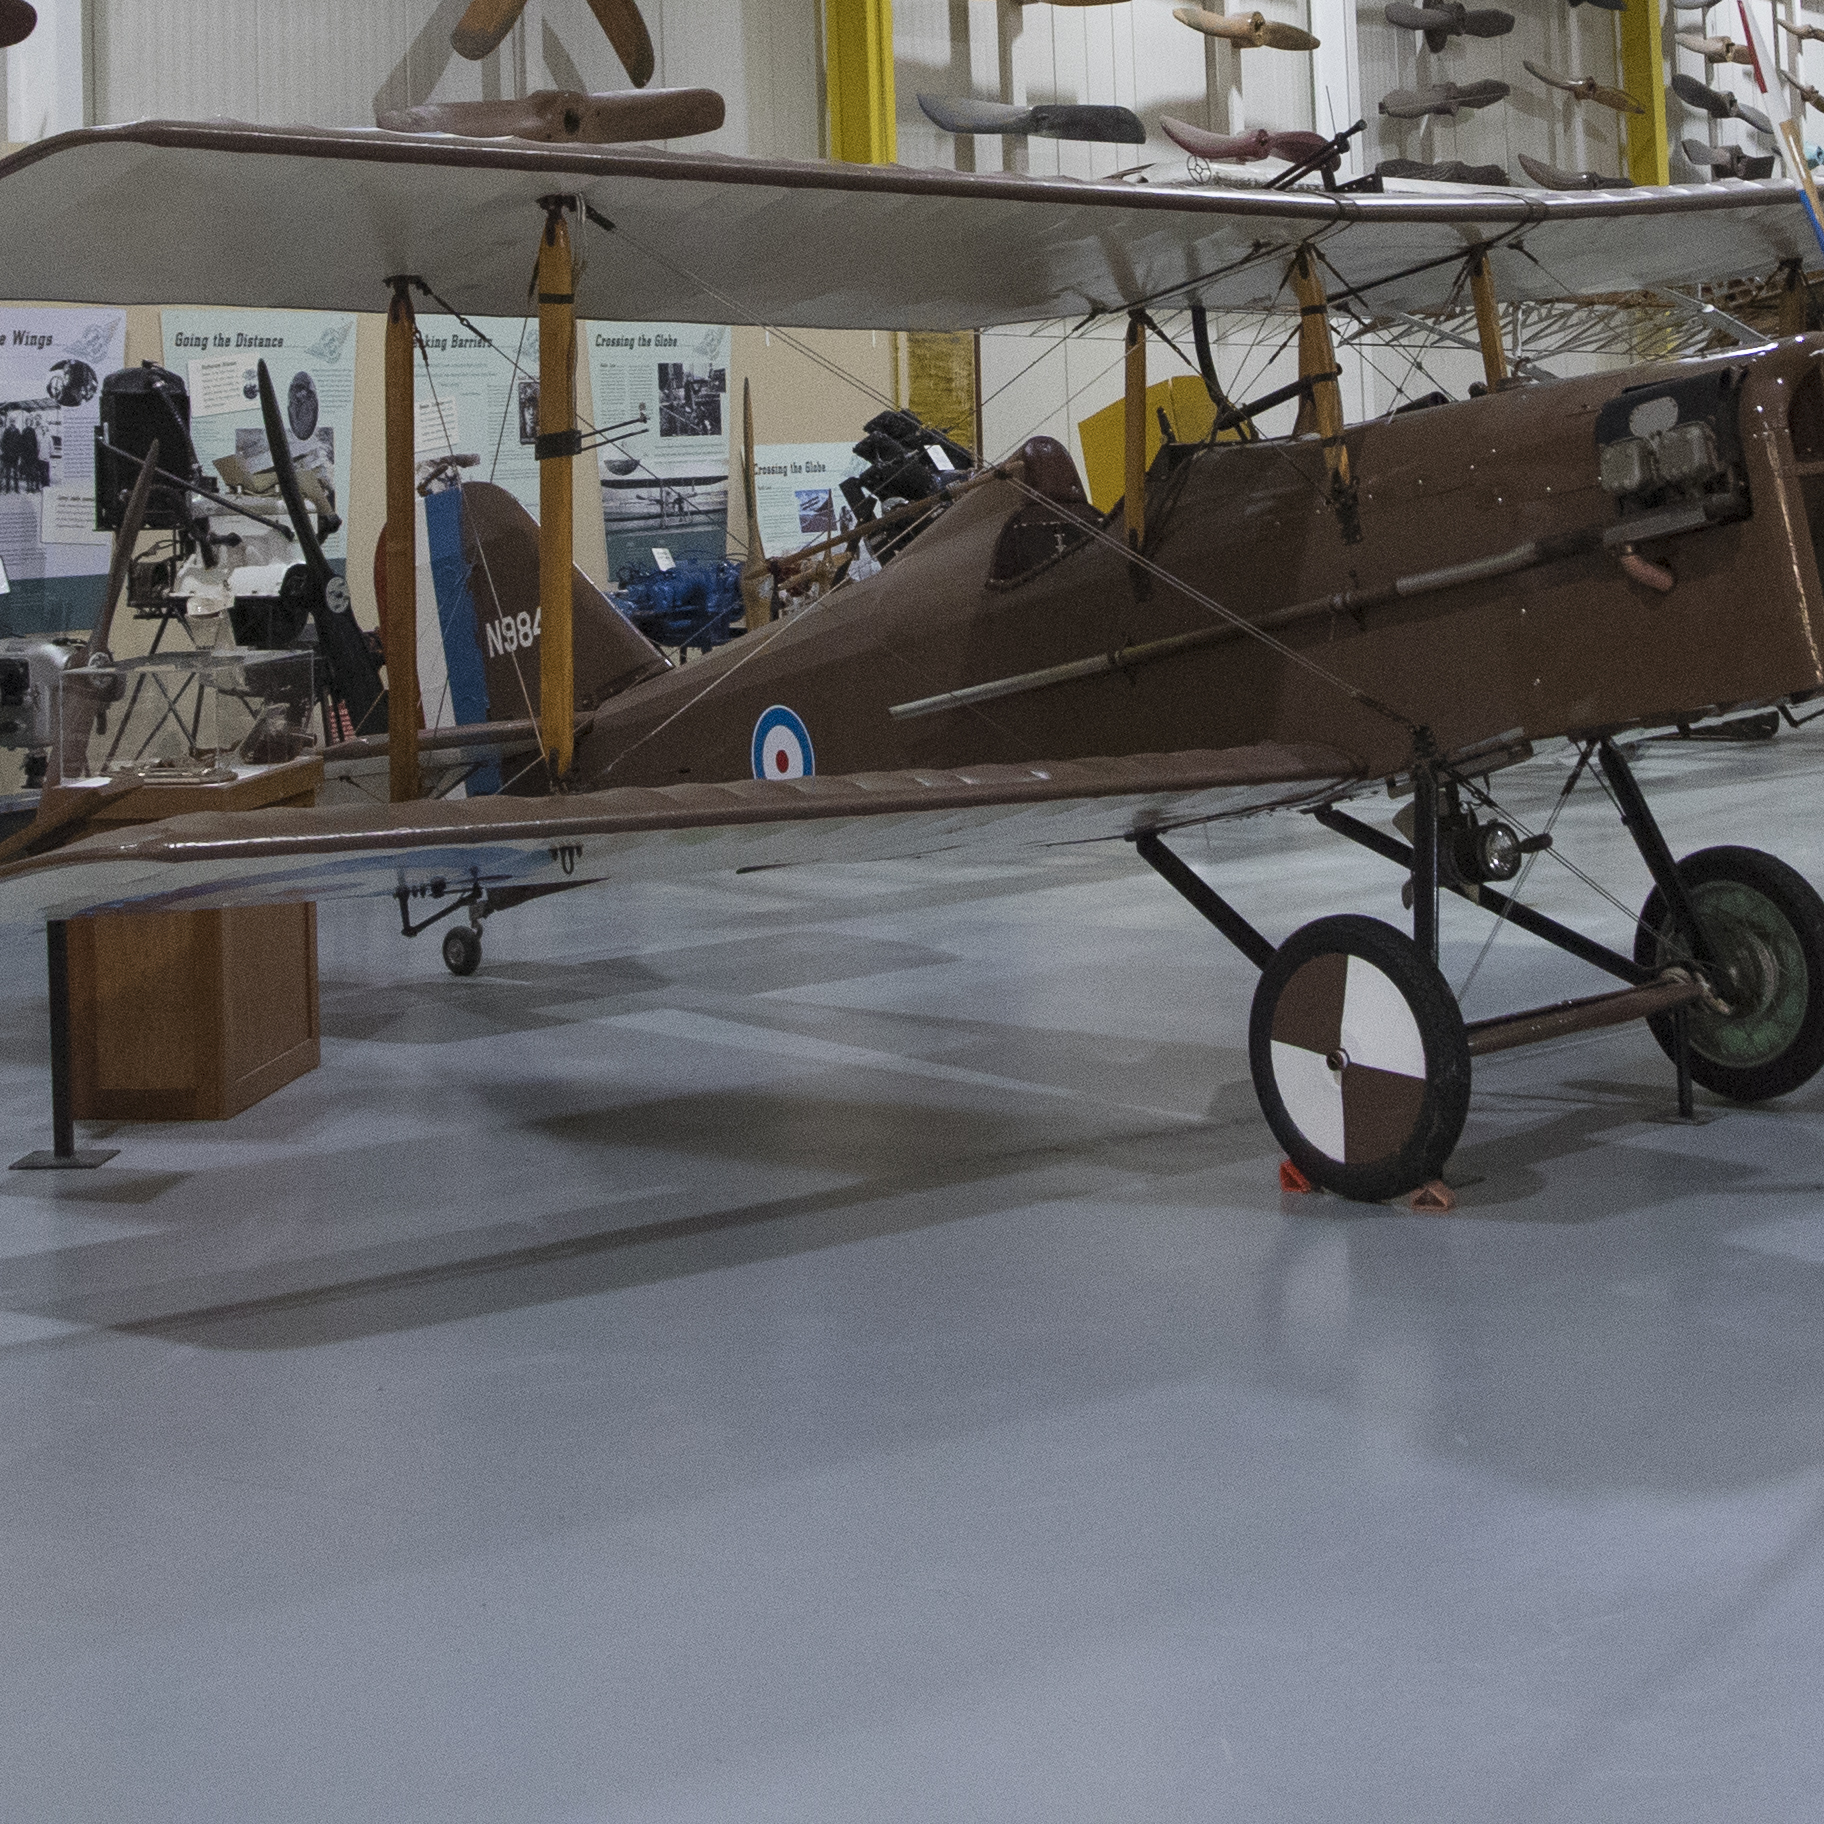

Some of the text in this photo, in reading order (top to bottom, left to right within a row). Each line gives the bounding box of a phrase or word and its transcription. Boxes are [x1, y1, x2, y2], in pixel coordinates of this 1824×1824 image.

[12, 329, 53, 349] Wings
[174, 332, 284, 350] Going the Distance
[451, 333, 493, 349] Barriers
[595, 334, 678, 350] Crossing the Globe
[754, 461, 826, 477] Crossing the Globe
